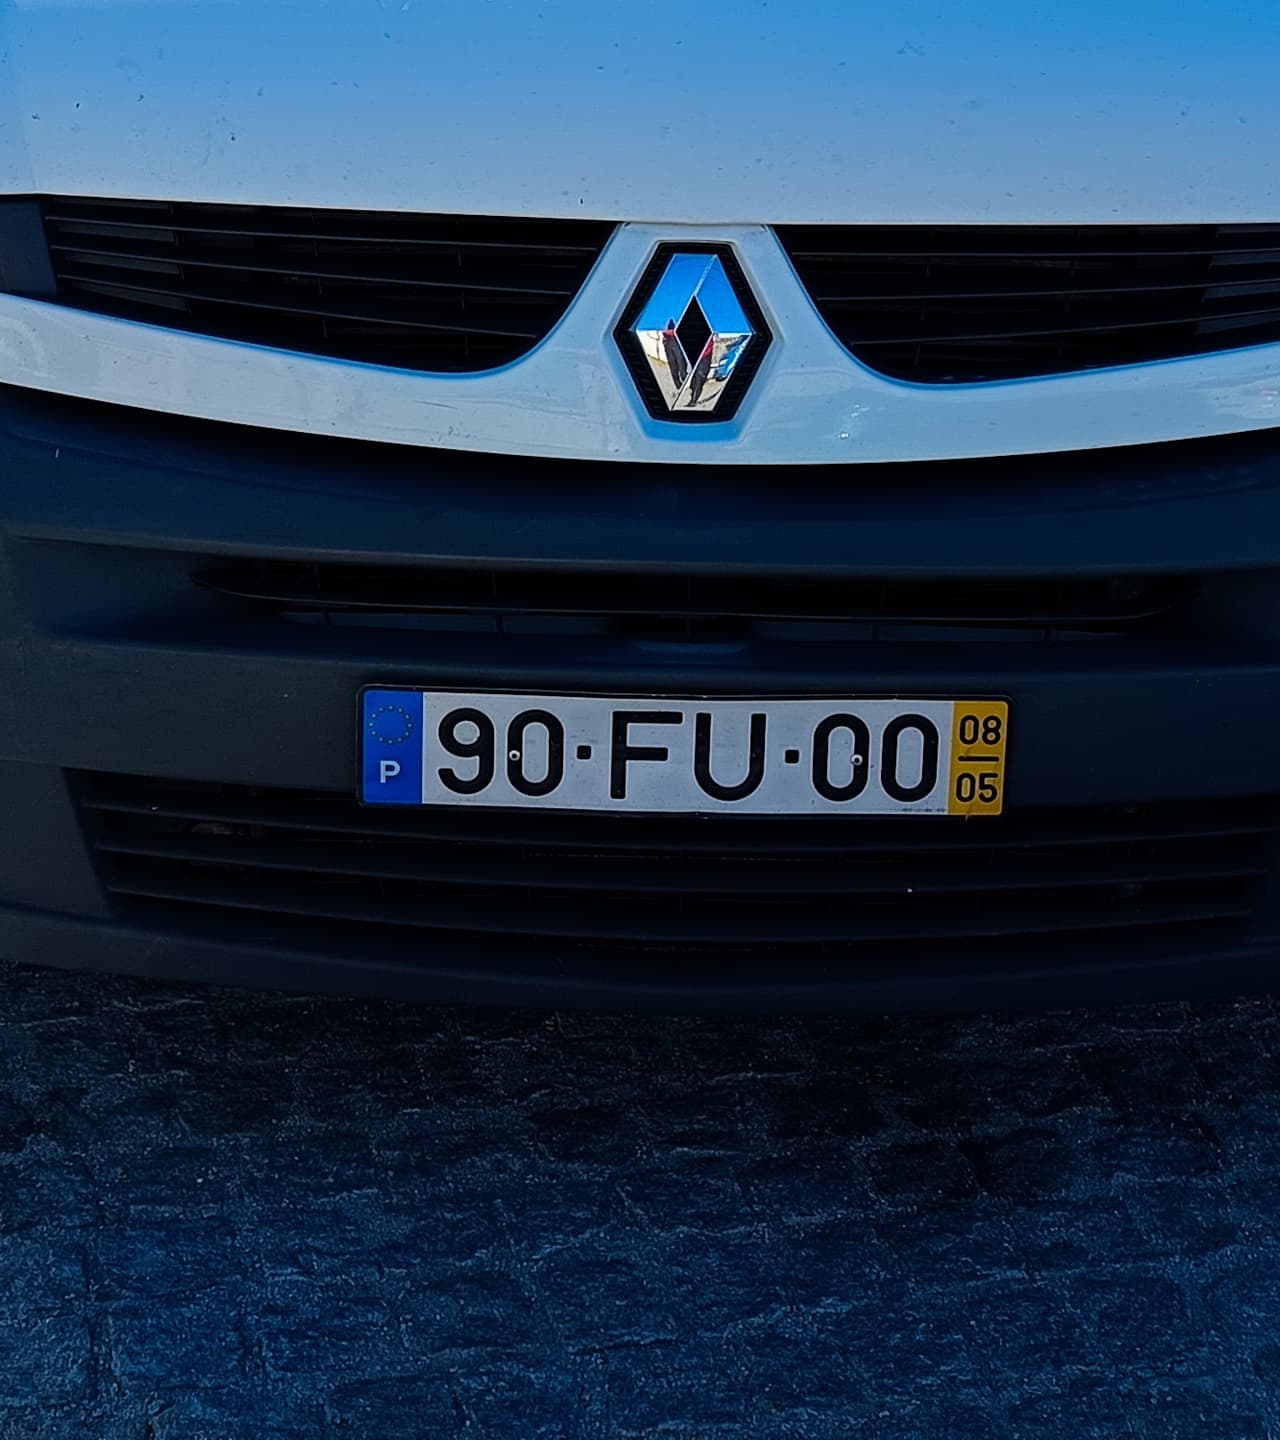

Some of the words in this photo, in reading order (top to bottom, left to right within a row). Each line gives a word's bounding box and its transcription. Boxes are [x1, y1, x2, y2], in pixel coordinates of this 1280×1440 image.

[959, 714, 1002, 746] 08
[380, 760, 401, 783] P
[955, 772, 999, 804] 05
